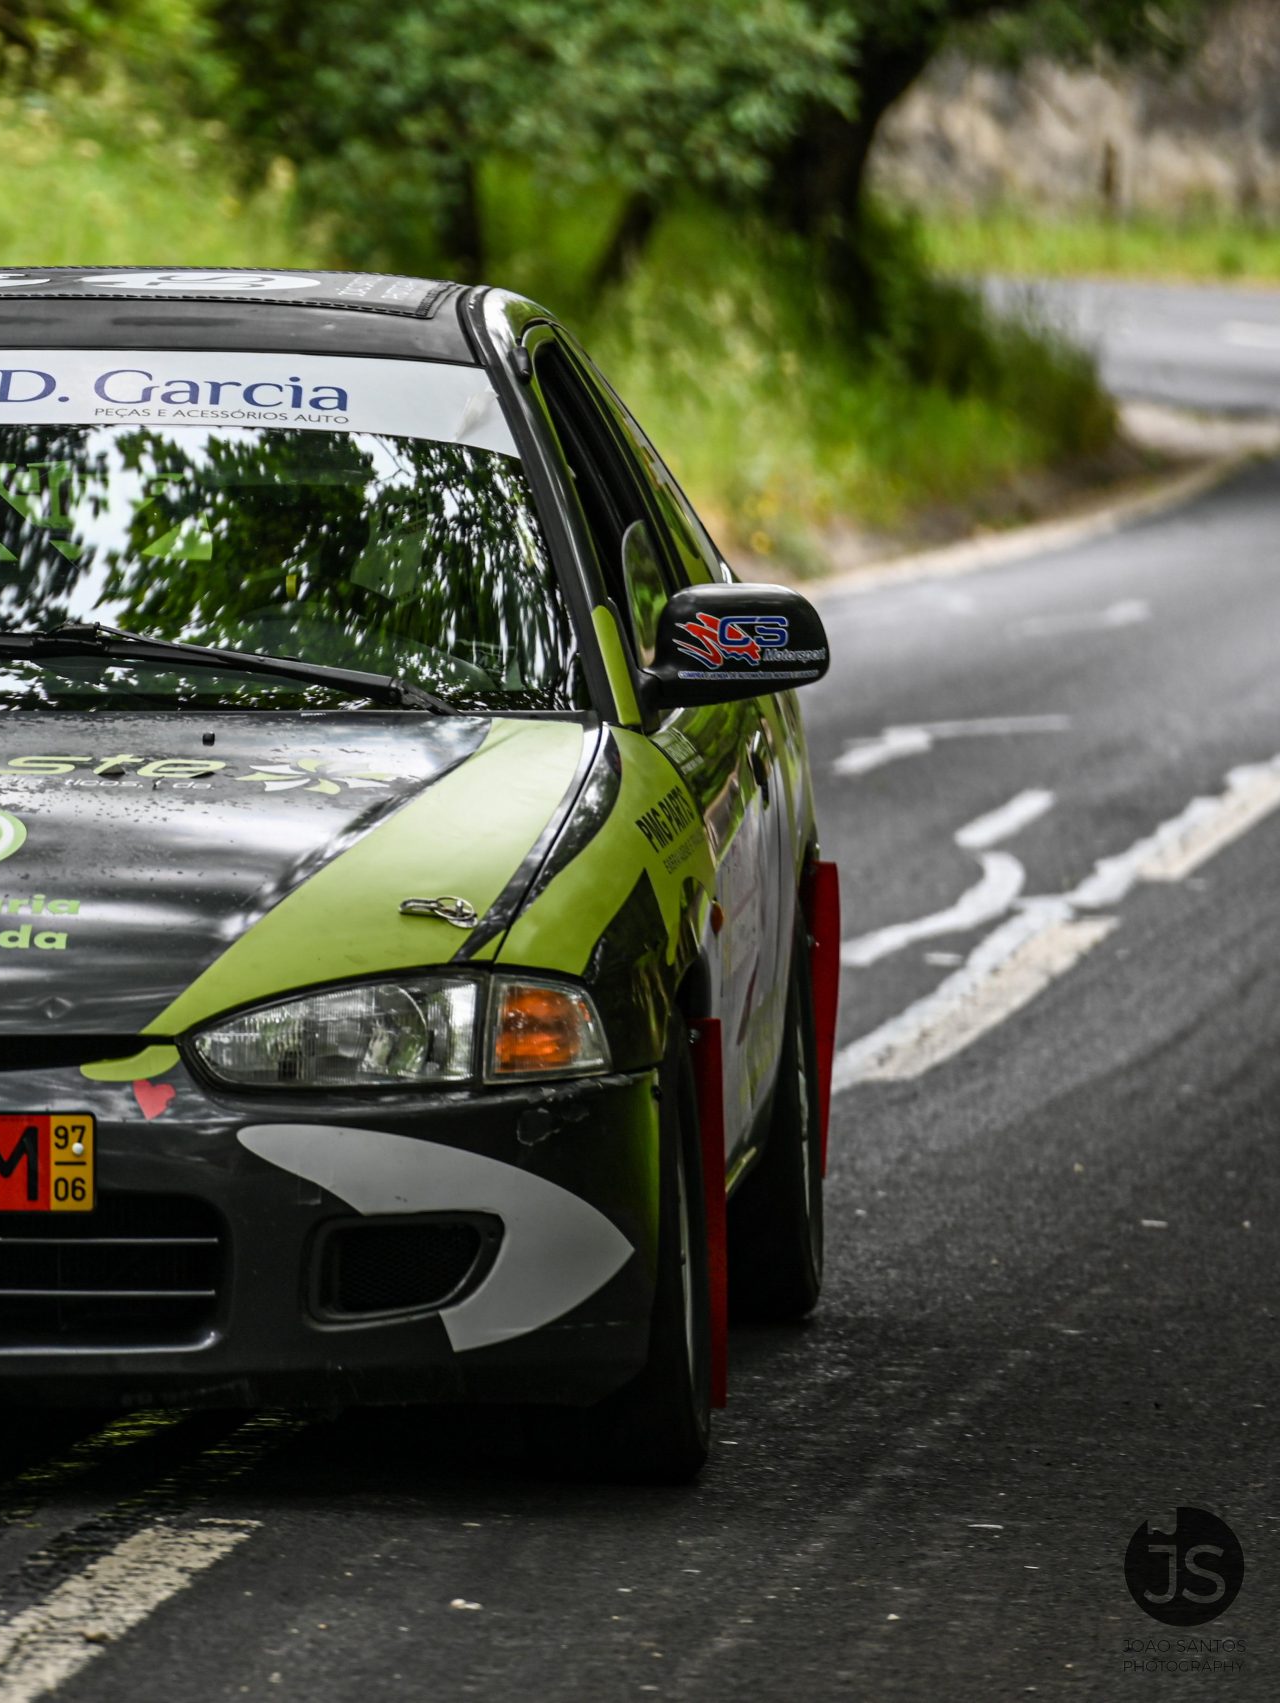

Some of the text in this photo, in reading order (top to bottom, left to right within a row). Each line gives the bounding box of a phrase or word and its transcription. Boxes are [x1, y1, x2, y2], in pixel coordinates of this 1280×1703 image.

[94, 369, 349, 412] Garcia
[94, 408, 349, 424] PEÇAS E ACESSÓRIOS AUTO
[763, 648, 825, 664] Motorsport
[53, 1125, 87, 1150] 97
[53, 1177, 87, 1202] 06
